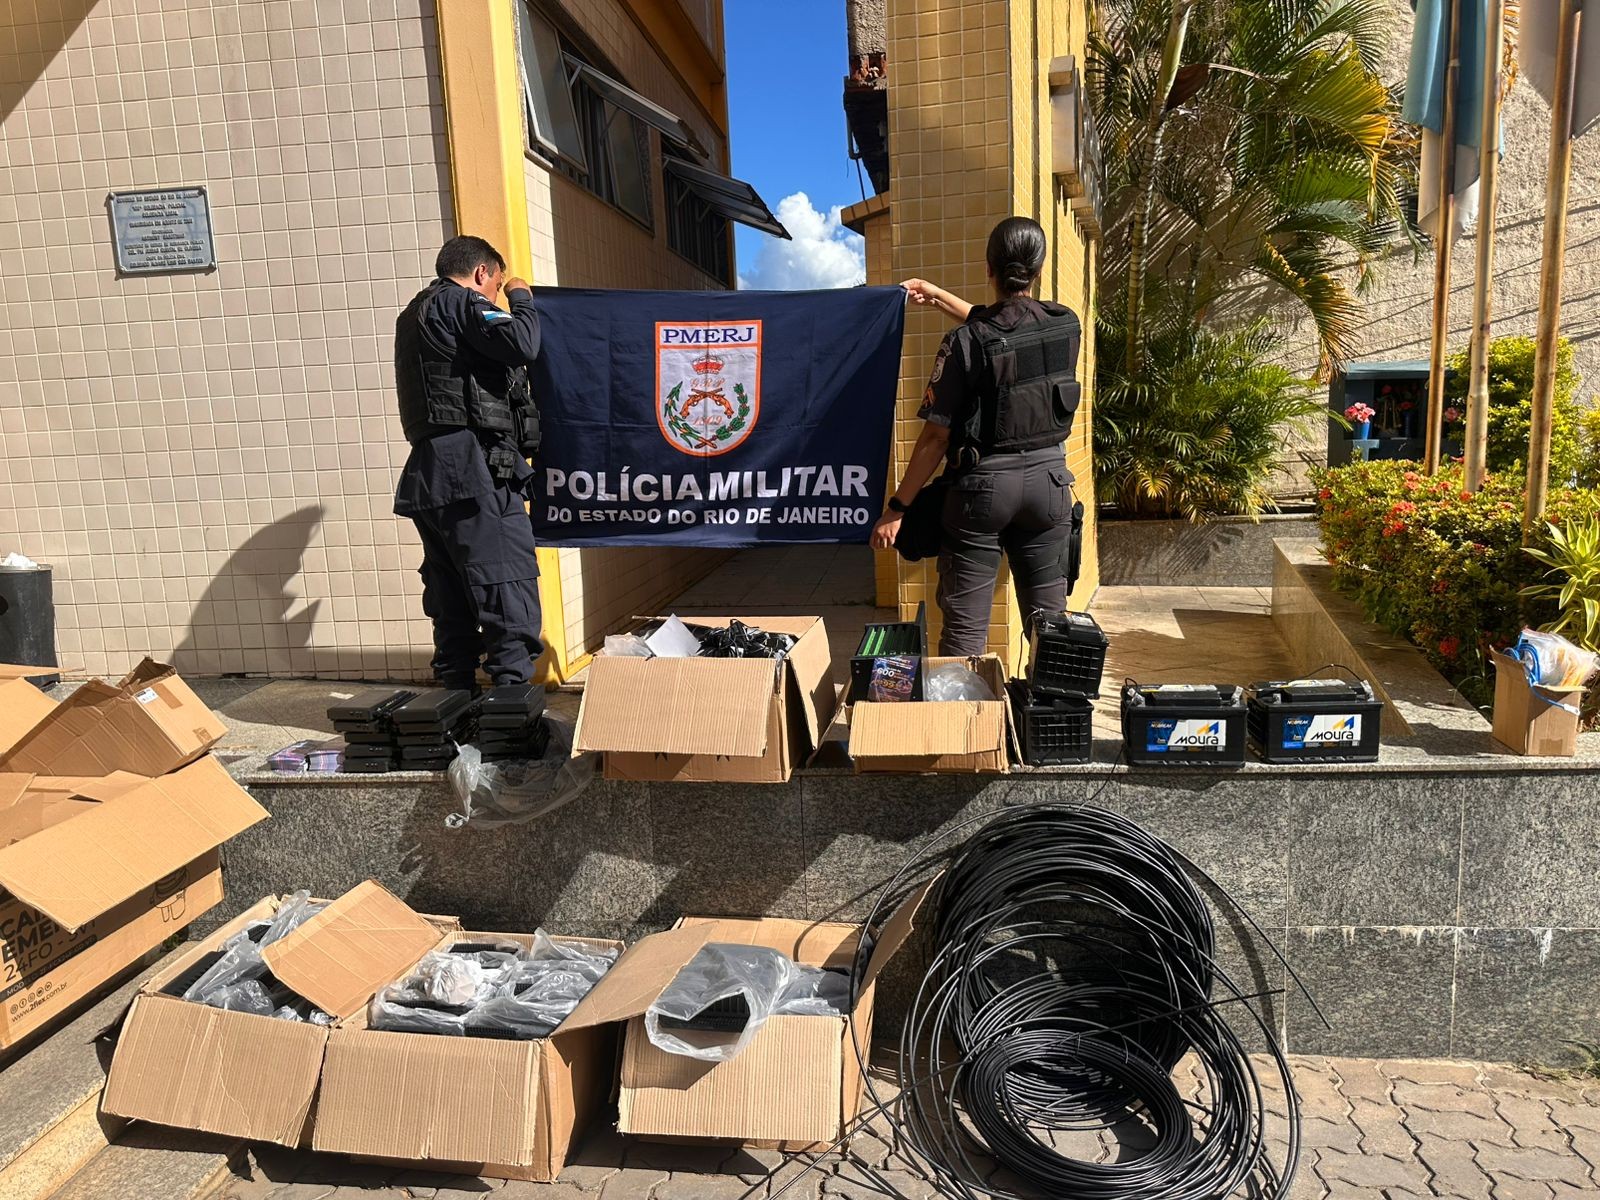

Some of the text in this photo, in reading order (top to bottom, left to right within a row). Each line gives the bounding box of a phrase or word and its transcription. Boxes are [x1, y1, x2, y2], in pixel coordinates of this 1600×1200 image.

[663, 327, 754, 344] PMERJ
[546, 464, 870, 502] POLÍCIA MILITAR
[547, 505, 870, 525] DO ESTADO DO RIO DE JANEIRO
[12, 982, 68, 1023] www.2flex.com.br
